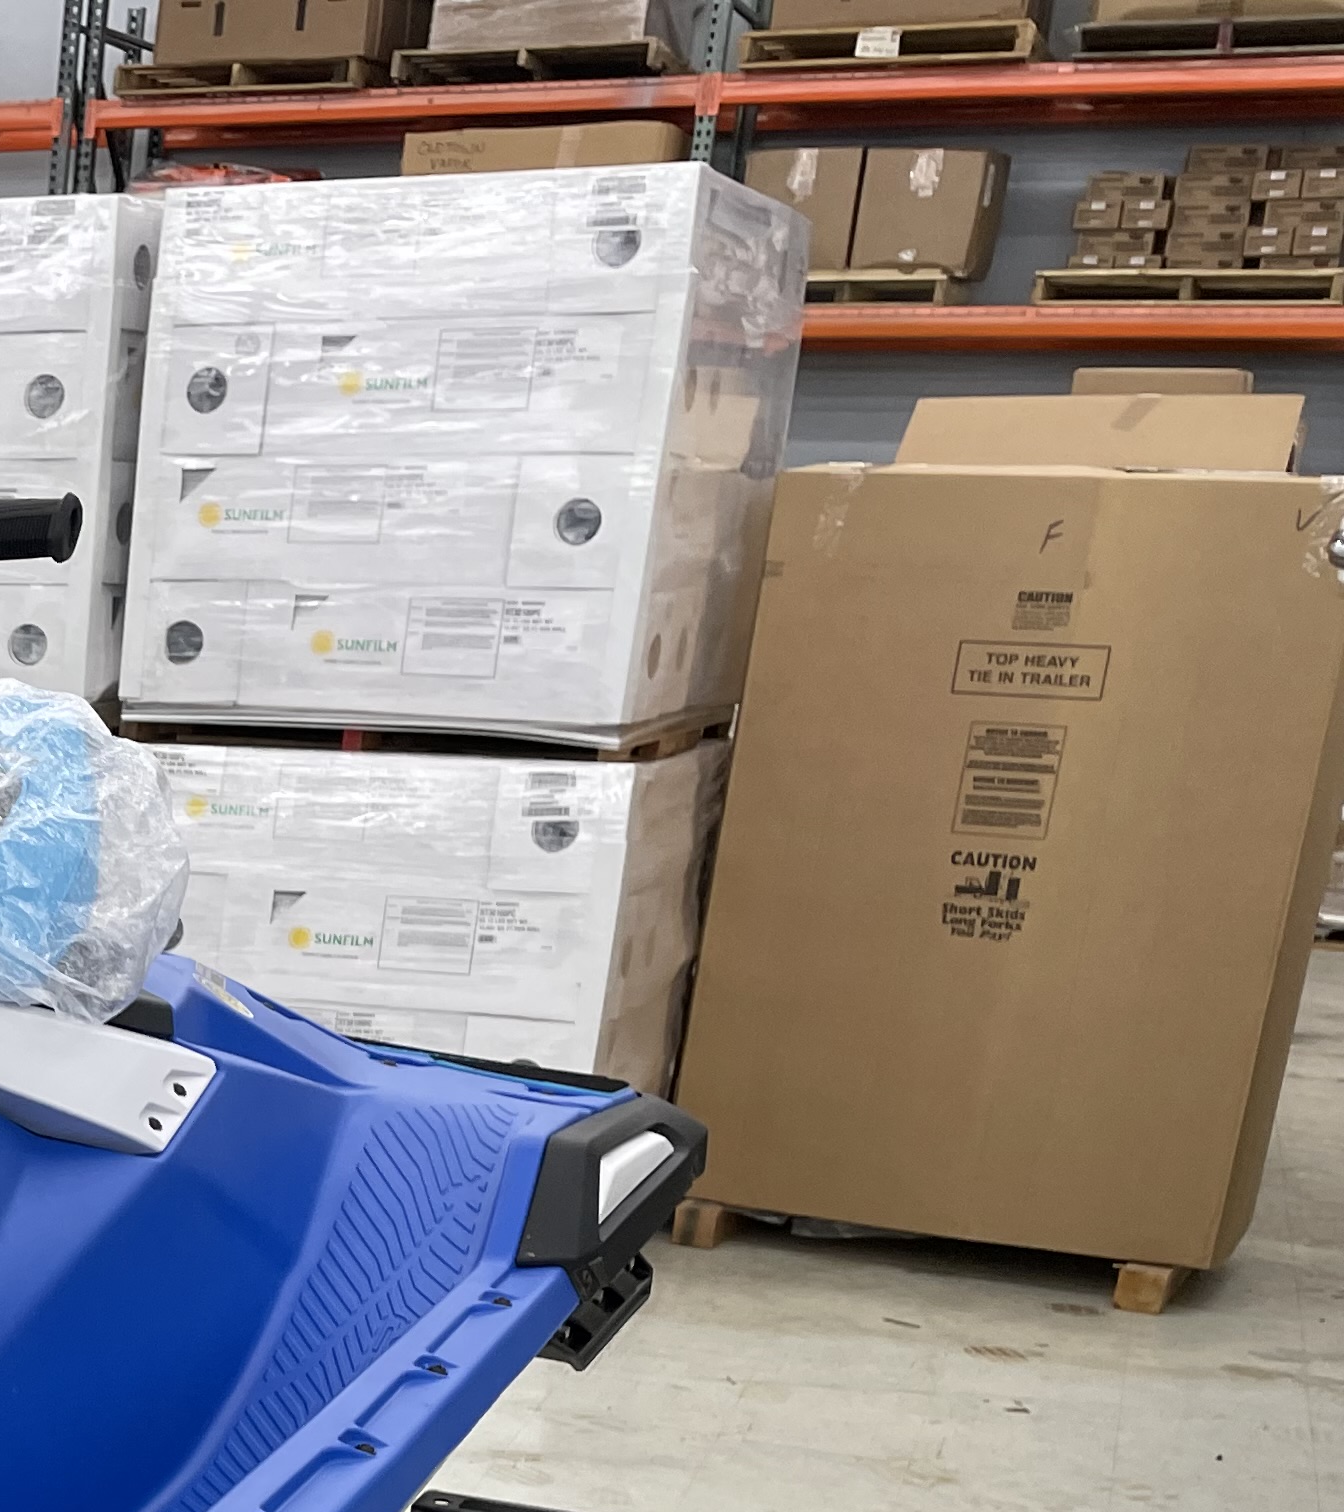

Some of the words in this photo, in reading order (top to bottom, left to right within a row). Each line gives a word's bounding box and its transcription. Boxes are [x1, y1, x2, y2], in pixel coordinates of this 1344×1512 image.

[365, 377, 428, 391] SUNFILM
[224, 508, 285, 521] SUNFILM
[1017, 591, 1074, 604] CAUTION
[337, 638, 399, 653] SUNFILM
[986, 652, 1019, 666] TOP
[1024, 654, 1080, 668] HEAVY
[968, 669, 993, 683] TIE
[998, 671, 1014, 684] IN
[1020, 672, 1091, 688] TRAILER
[210, 803, 270, 818] SUNFILM
[951, 850, 1037, 871] CAUTION
[314, 932, 374, 947] SUNFILM
